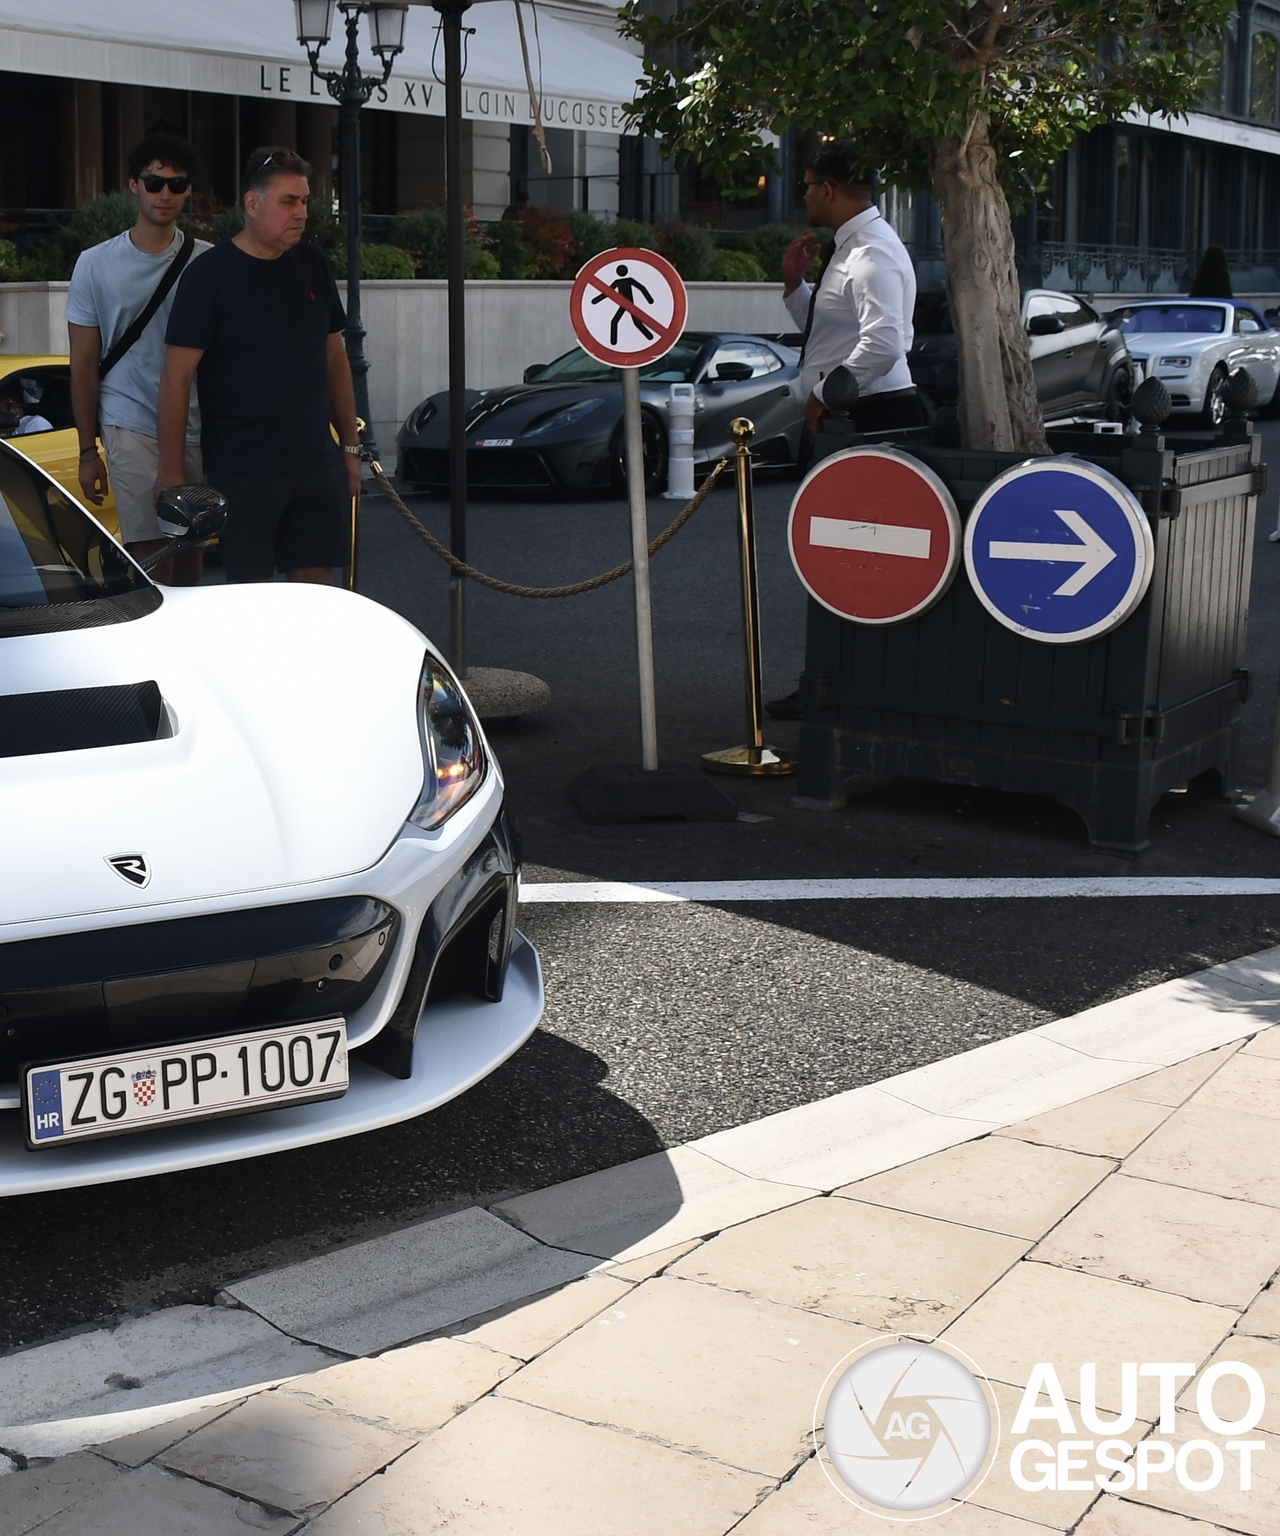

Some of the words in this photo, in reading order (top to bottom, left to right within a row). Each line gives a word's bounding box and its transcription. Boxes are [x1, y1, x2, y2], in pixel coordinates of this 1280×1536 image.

[260, 64, 291, 93] LE
[404, 81, 433, 108] XV
[465, 89, 515, 117] LAIN
[67, 1066, 127, 1126] ZG
[36, 1112, 61, 1130] HR
